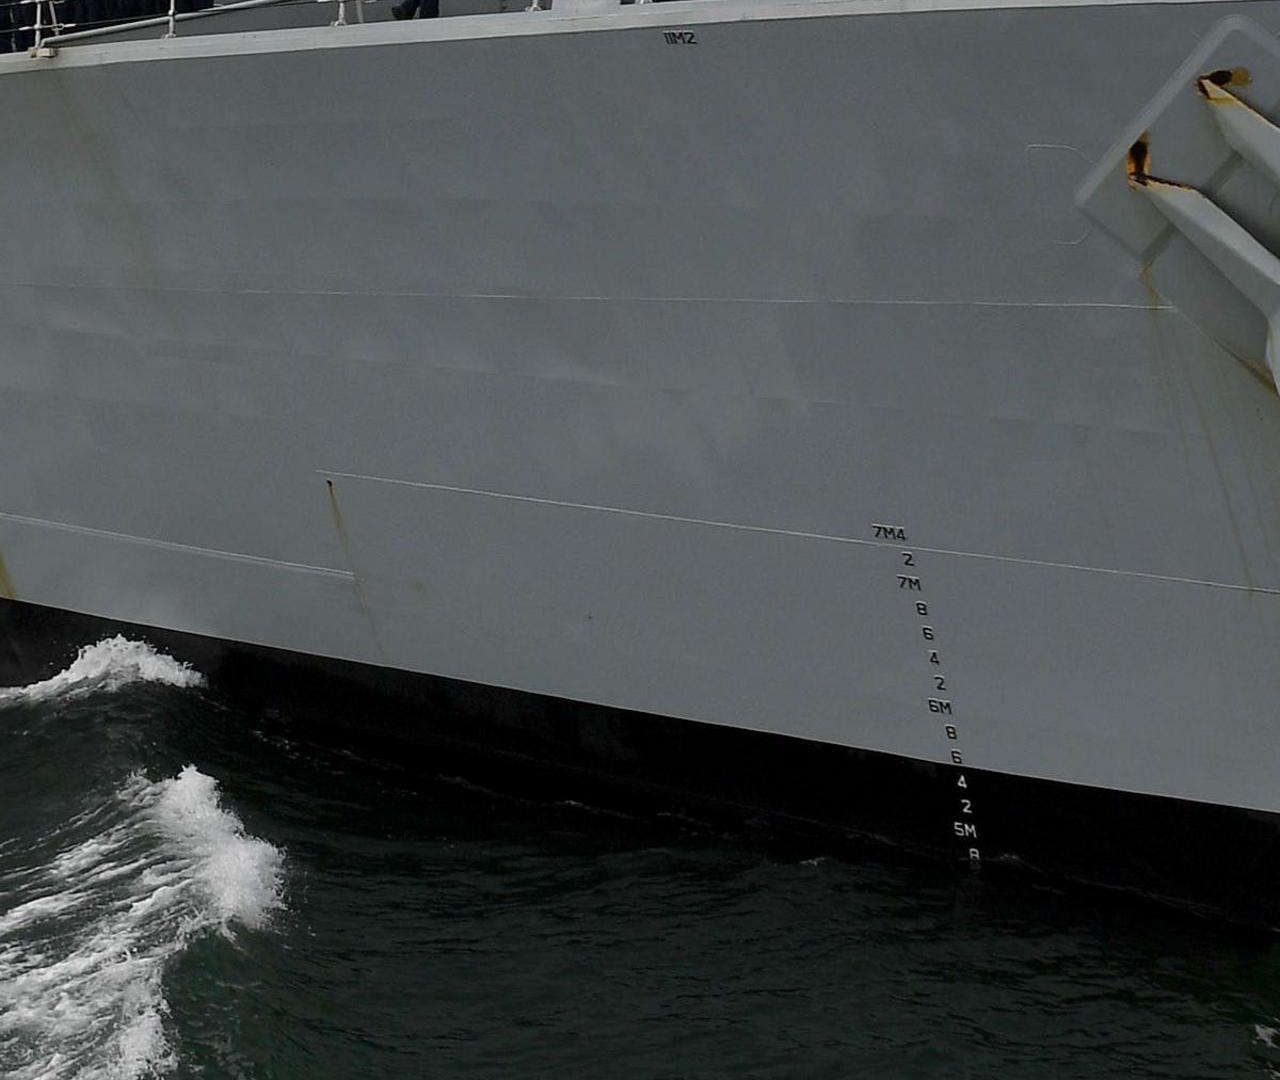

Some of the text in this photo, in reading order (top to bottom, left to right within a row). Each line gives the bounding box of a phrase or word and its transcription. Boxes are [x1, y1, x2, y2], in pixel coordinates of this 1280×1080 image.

[872, 524, 907, 541] 7M4
[902, 551, 915, 567] 2
[896, 575, 922, 591] 7M
[916, 602, 928, 616] 8
[922, 626, 934, 641] 6
[929, 651, 940, 666] 4
[934, 675, 947, 691] 2
[928, 699, 953, 716] 6M
[945, 725, 958, 740] 8
[951, 750, 962, 765] 6
[957, 774, 968, 789] 4
[961, 799, 973, 814] 2
[953, 821, 977, 839] 5M
